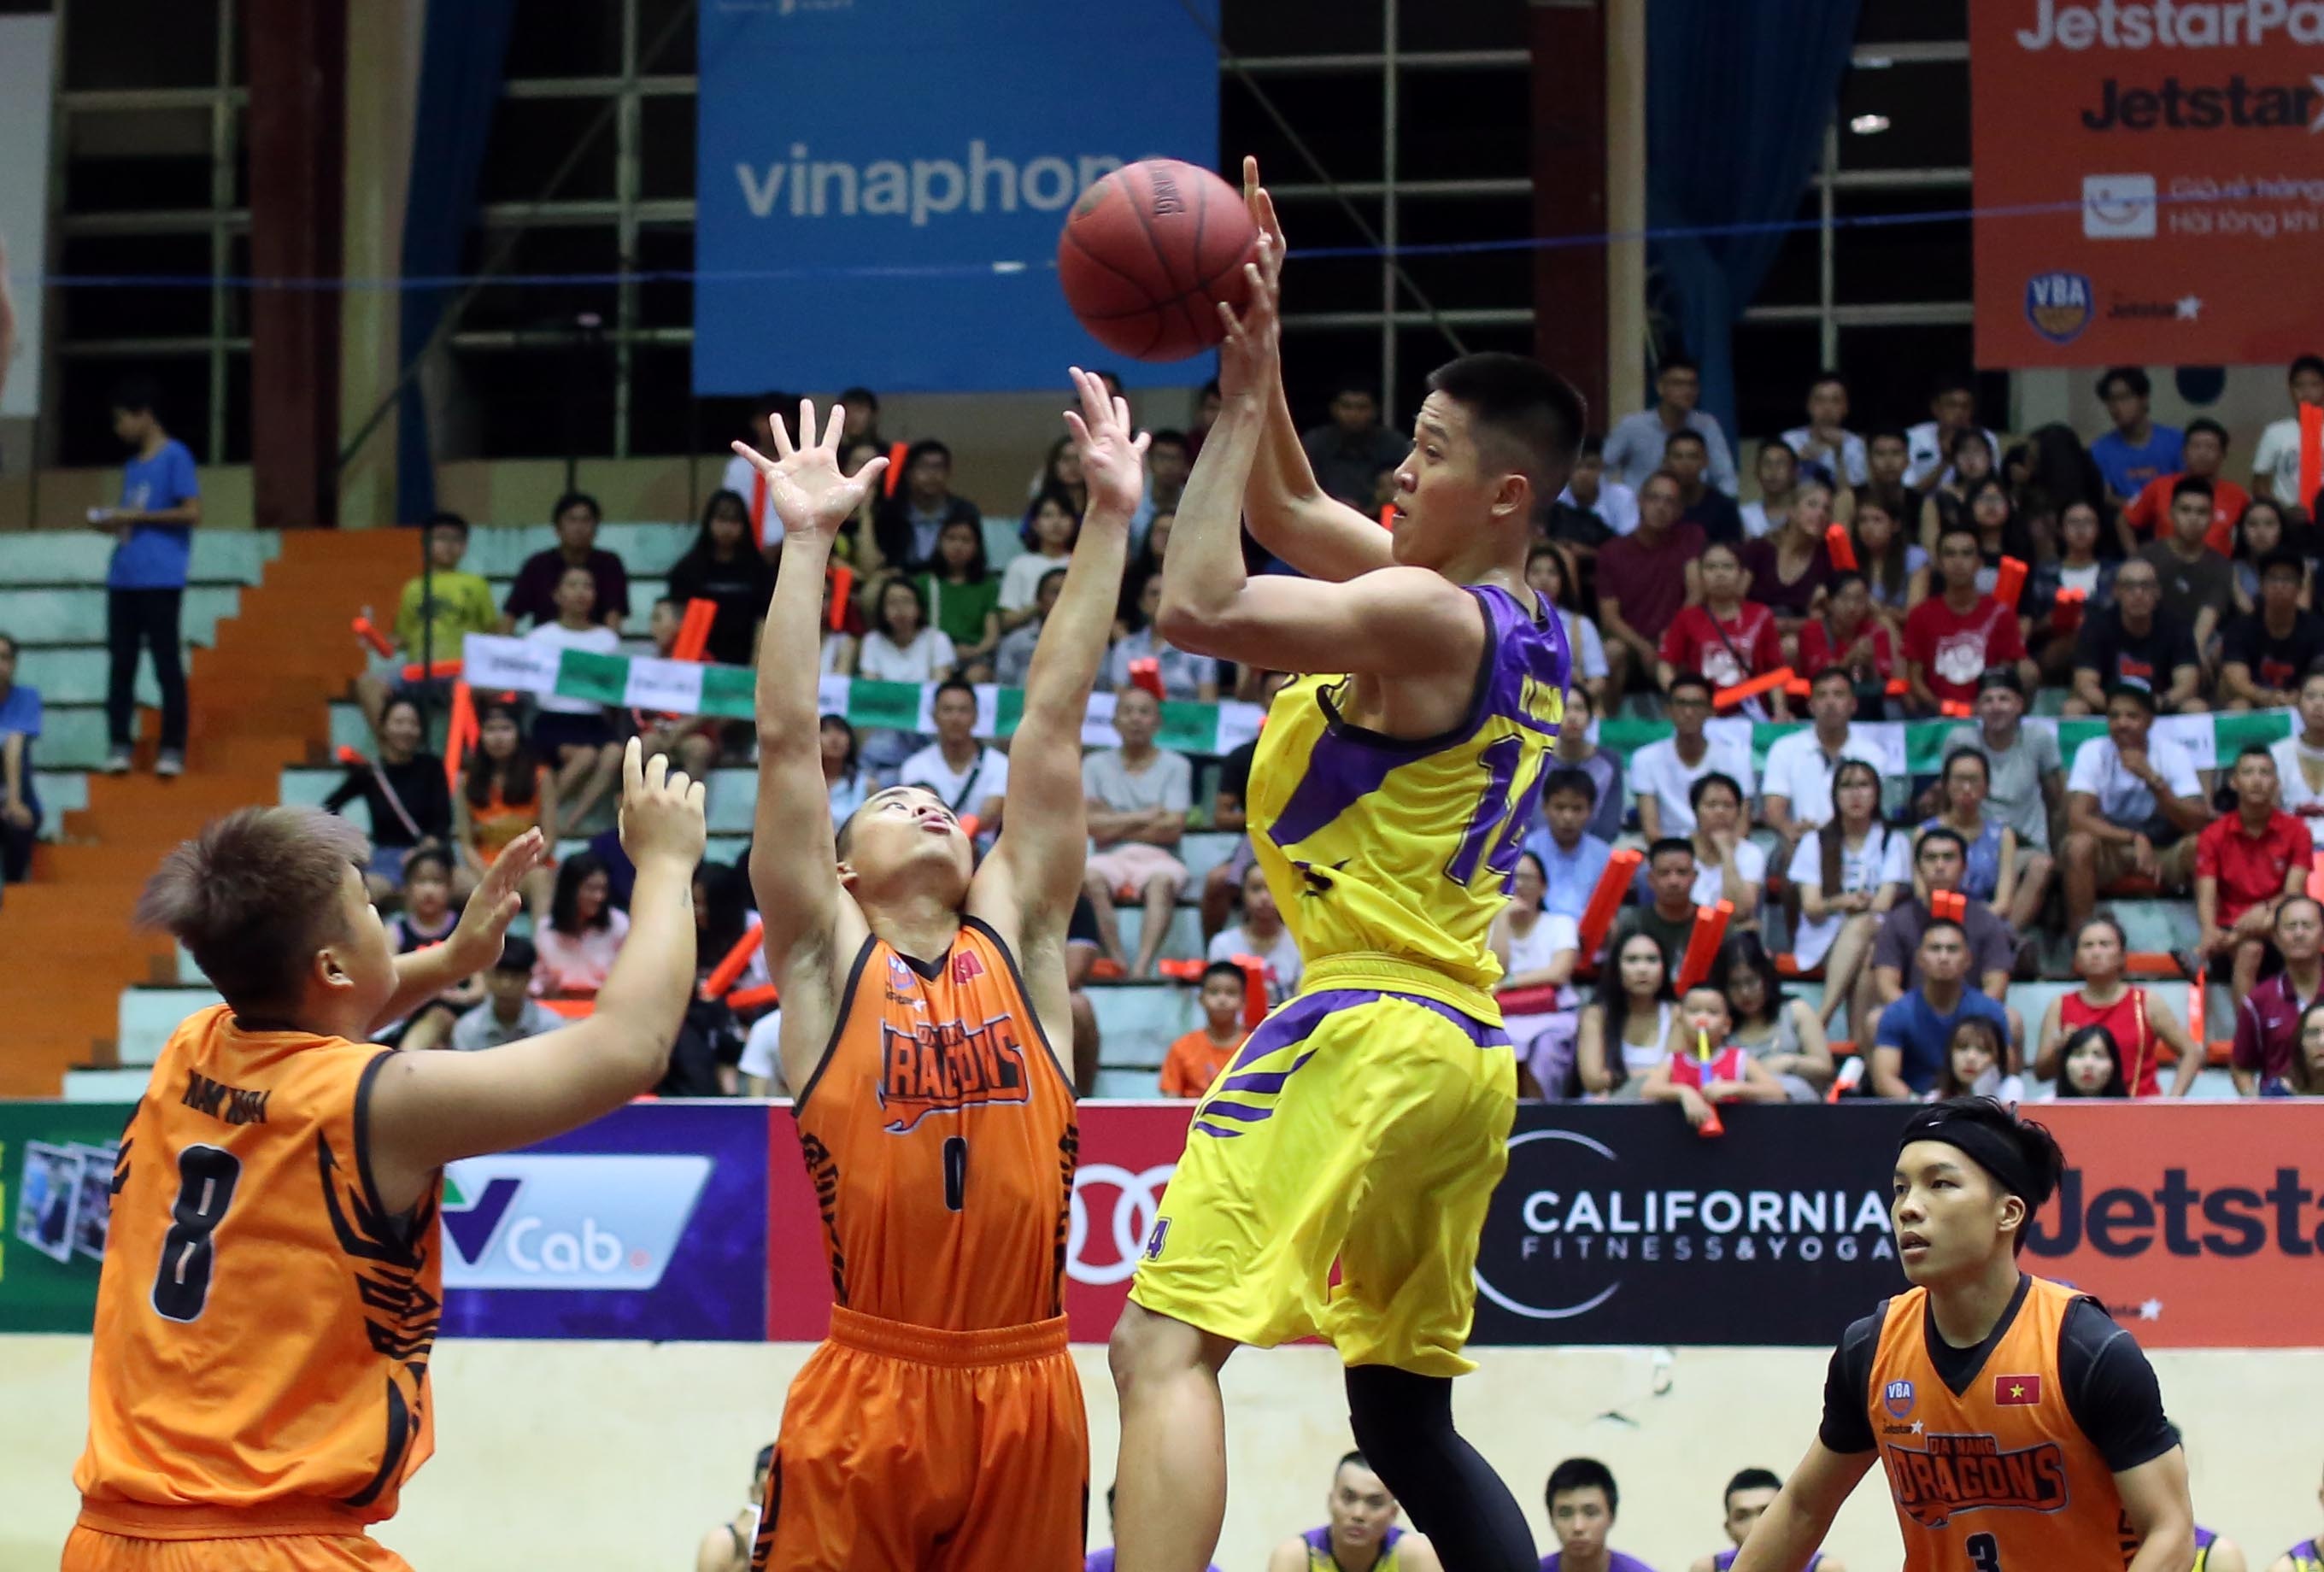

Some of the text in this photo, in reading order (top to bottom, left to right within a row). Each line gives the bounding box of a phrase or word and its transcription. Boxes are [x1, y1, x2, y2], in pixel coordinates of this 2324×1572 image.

[2081, 75, 2313, 132] Jetstar
[736, 139, 1141, 226] vinaphon
[2032, 274, 2085, 308] VBA
[943, 1136, 968, 1211] 0
[150, 1142, 242, 1323] 8
[1523, 1191, 1891, 1234] CALIFORNIA
[2024, 1168, 2324, 1259] Jetst
[1887, 1382, 1910, 1399] VBA
[1888, 1444, 2069, 1509] DRAGONS
